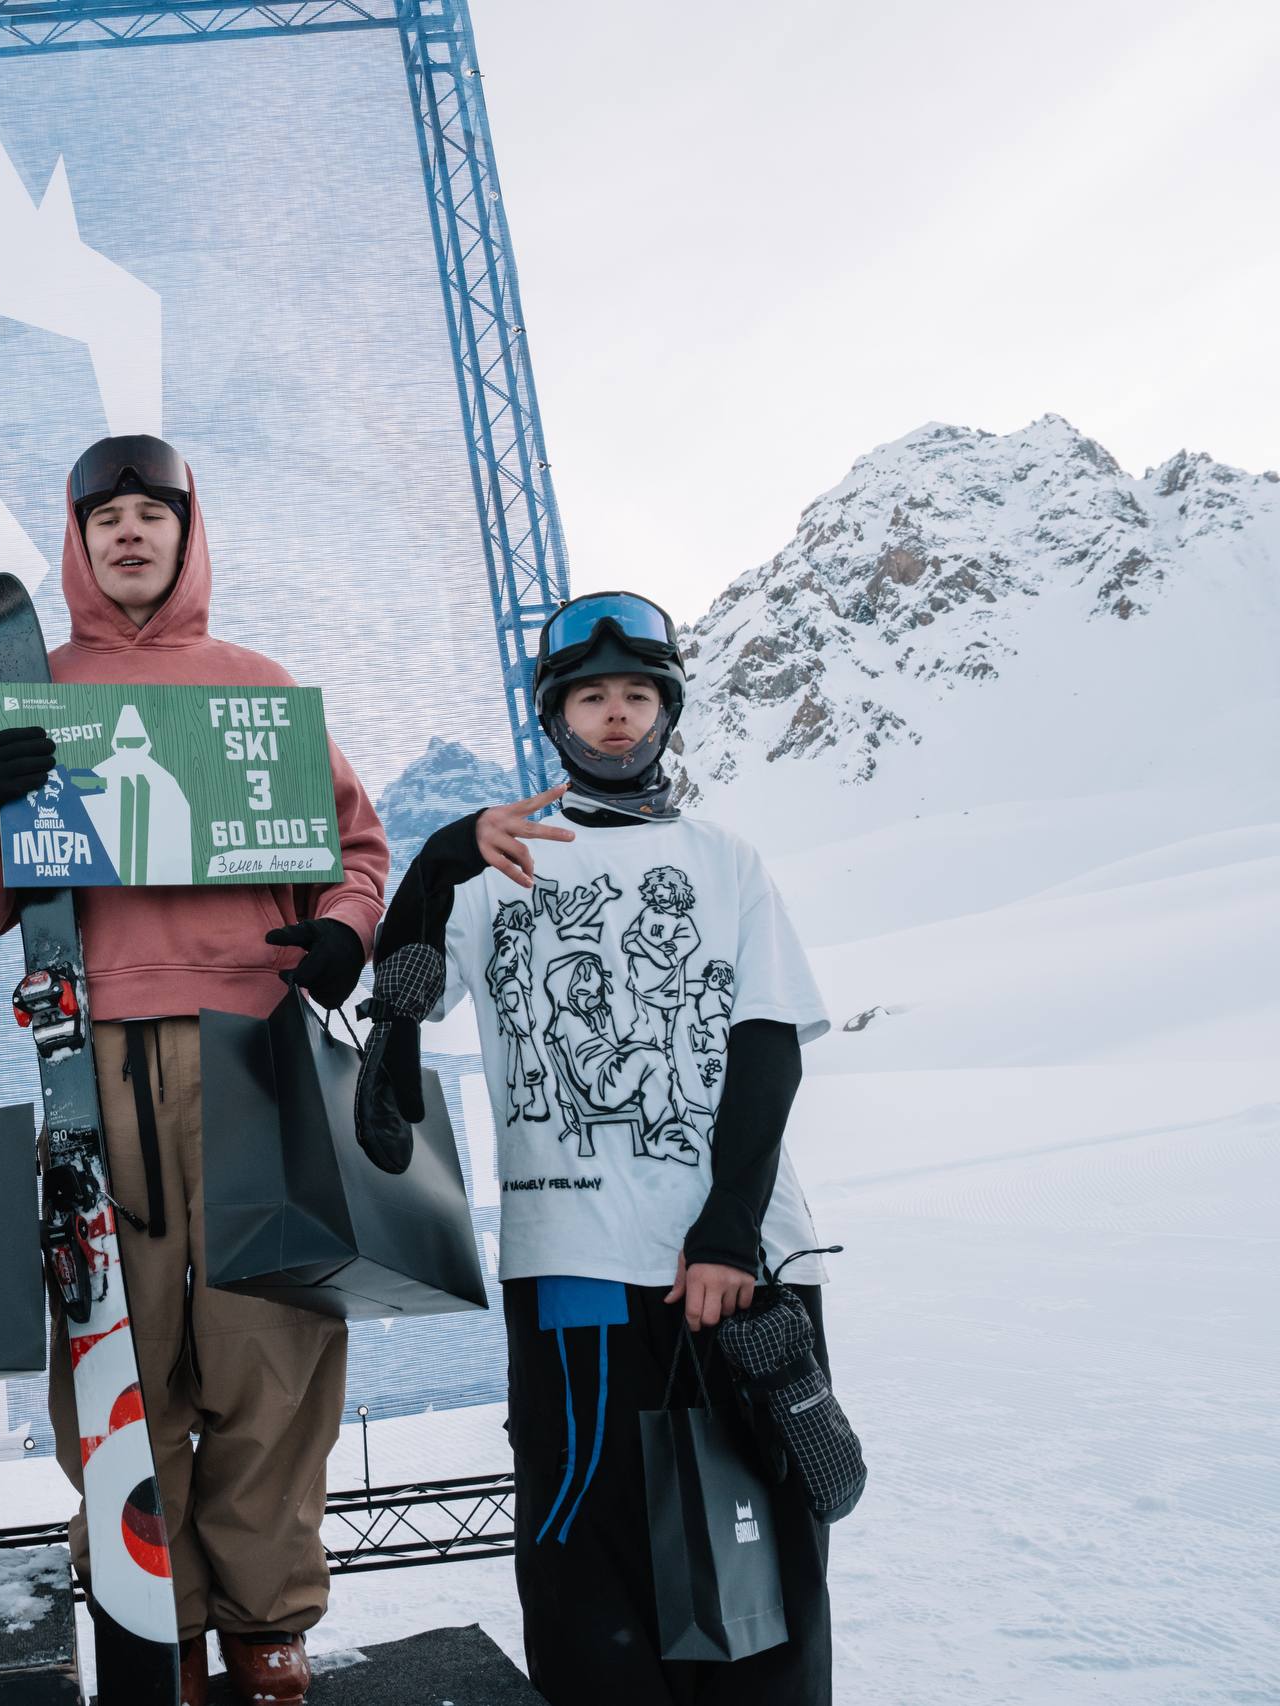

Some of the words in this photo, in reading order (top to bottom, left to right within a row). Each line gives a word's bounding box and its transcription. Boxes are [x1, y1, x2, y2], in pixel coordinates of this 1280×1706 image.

[209, 697, 290, 728] FREE
[46, 723, 102, 743] 2SPOT
[224, 730, 279, 761] SKI
[246, 770, 272, 811] 3
[34, 818, 65, 829] GORILLA
[211, 820, 246, 847] 60
[13, 830, 93, 865] IMBA
[36, 864, 70, 877] PARK
[218, 855, 263, 873] Земель
[269, 855, 313, 872] Андрей
[52, 1129, 67, 1142] 90
[548, 1178, 572, 1190] FEEL
[573, 1177, 602, 1191] MANY
[734, 1519, 761, 1543] GORILLA
